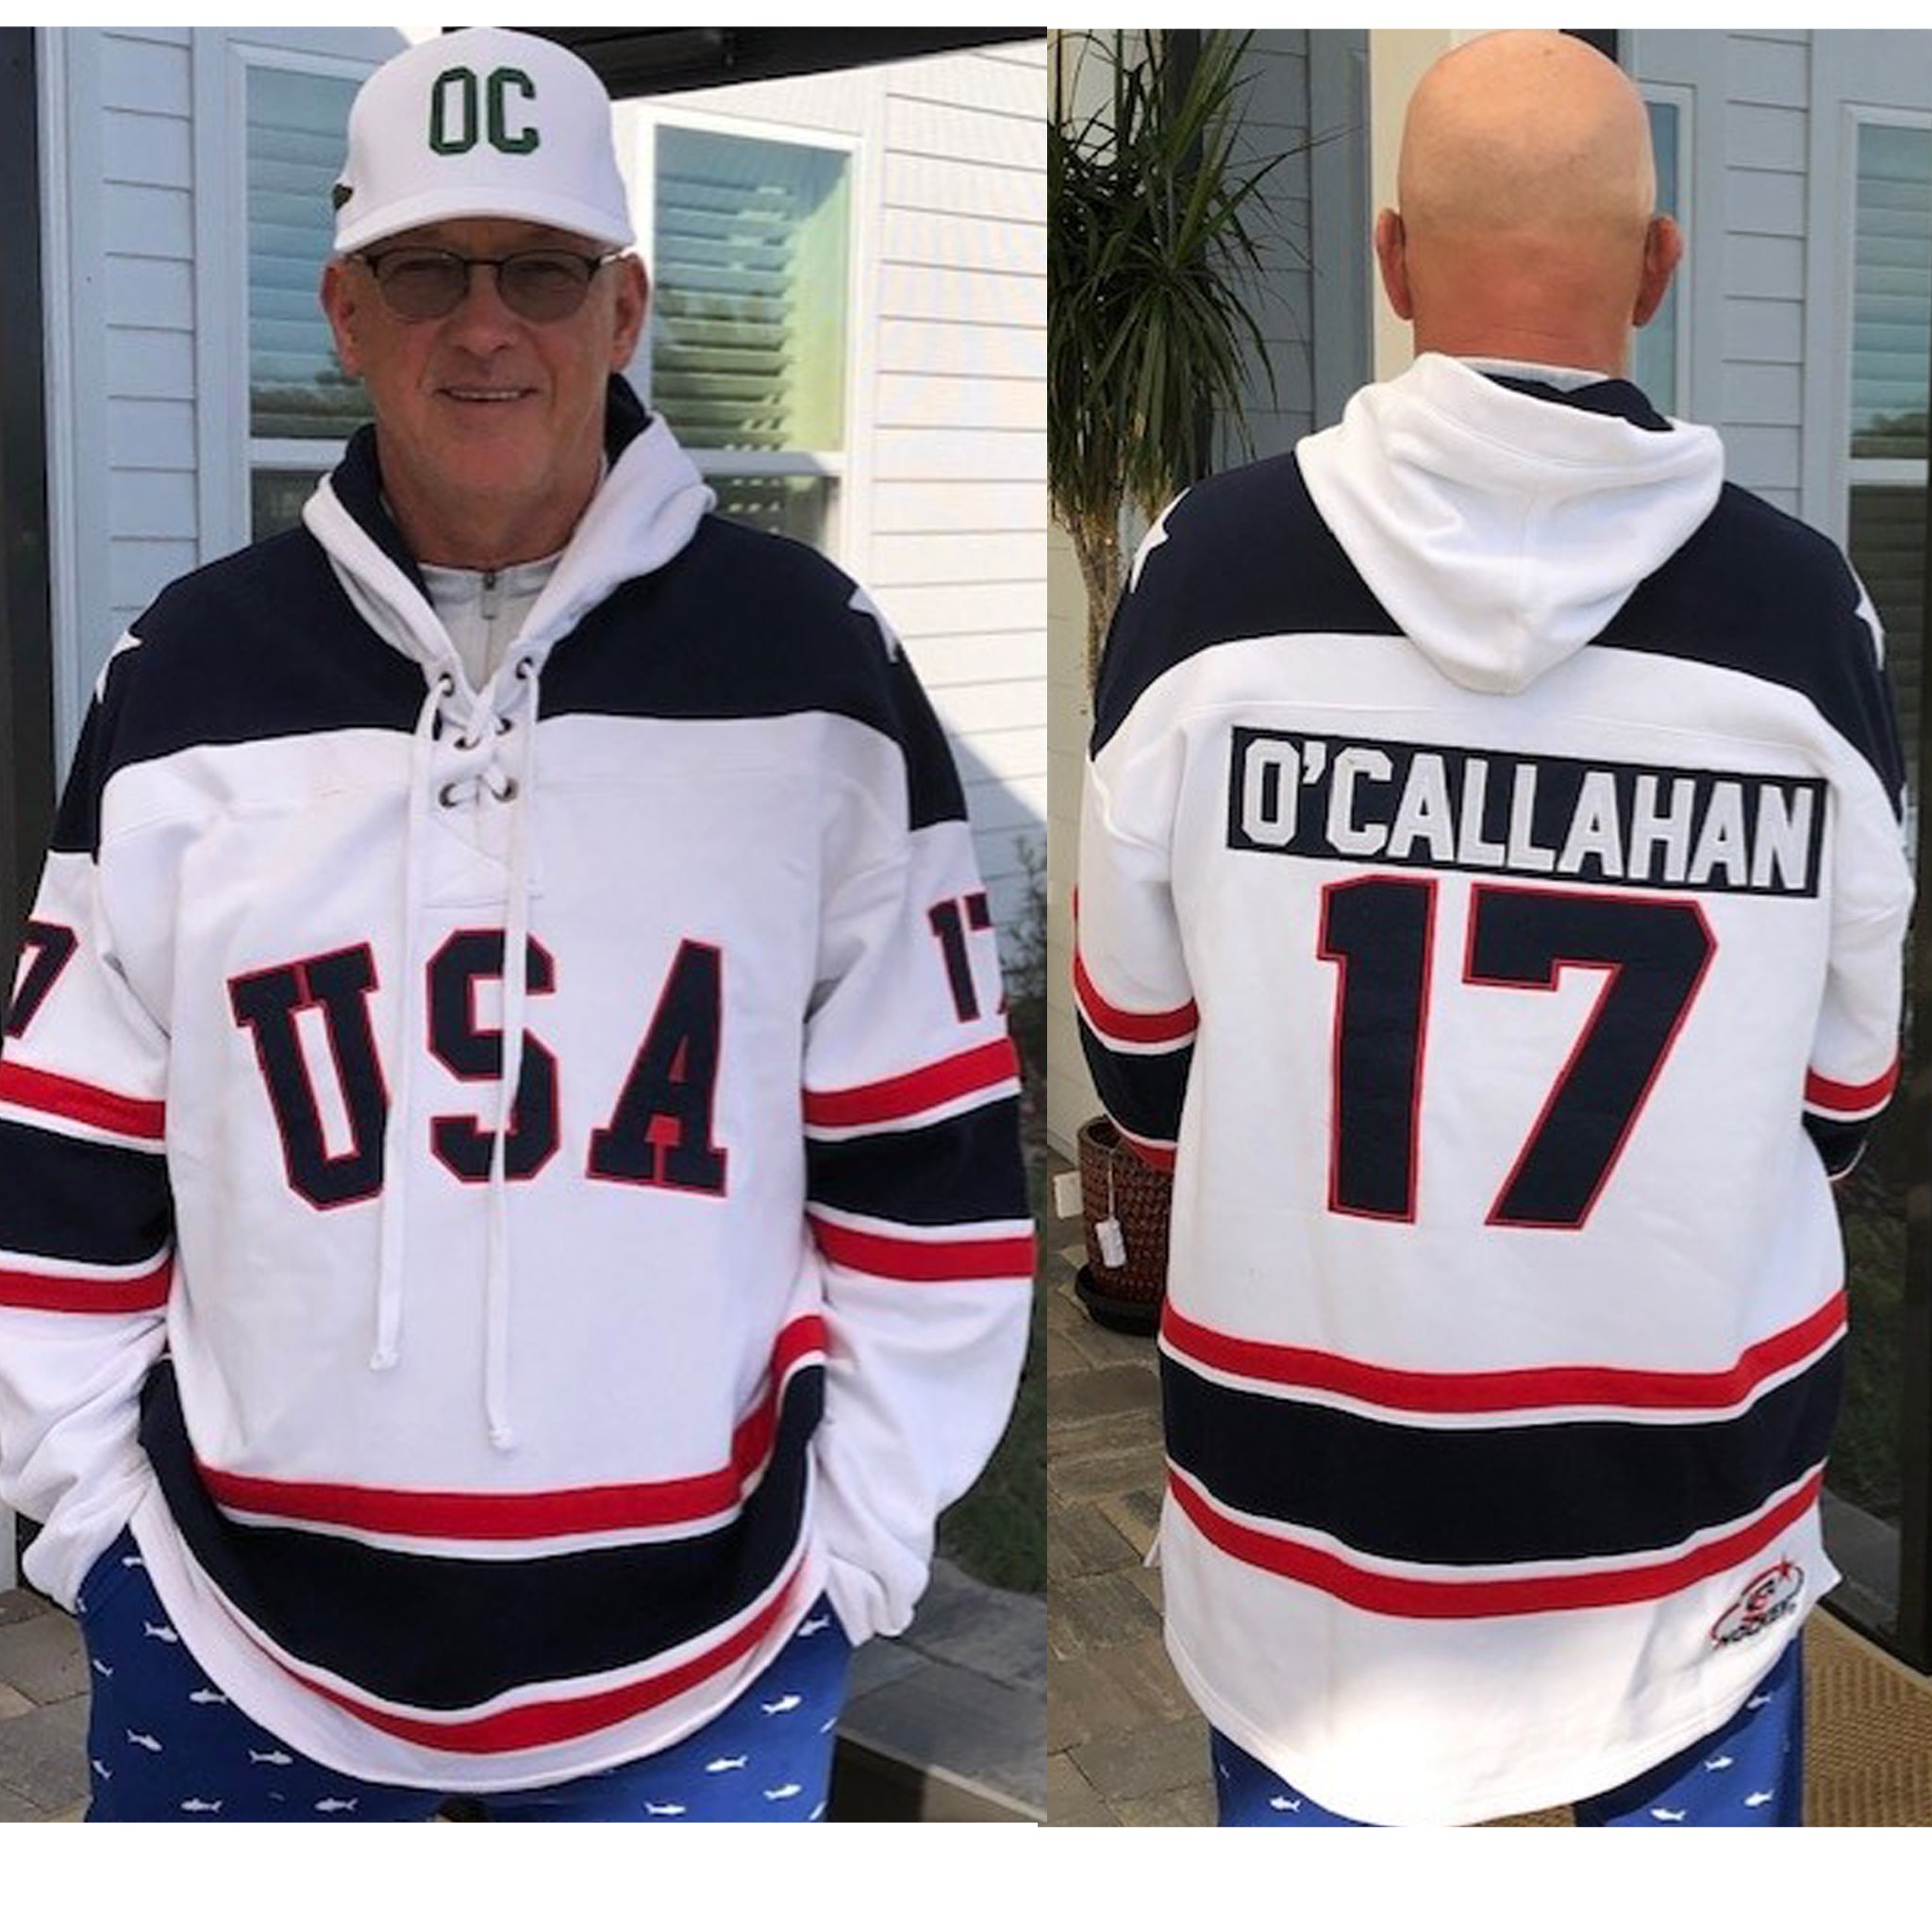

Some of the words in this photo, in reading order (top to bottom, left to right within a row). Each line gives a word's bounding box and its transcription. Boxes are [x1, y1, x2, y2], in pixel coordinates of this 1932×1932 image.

[429, 66, 540, 156] OC
[1241, 738, 1814, 891] O'CALLAHAN
[226, 928, 728, 1211] USA
[1317, 874, 1718, 1230] 17
